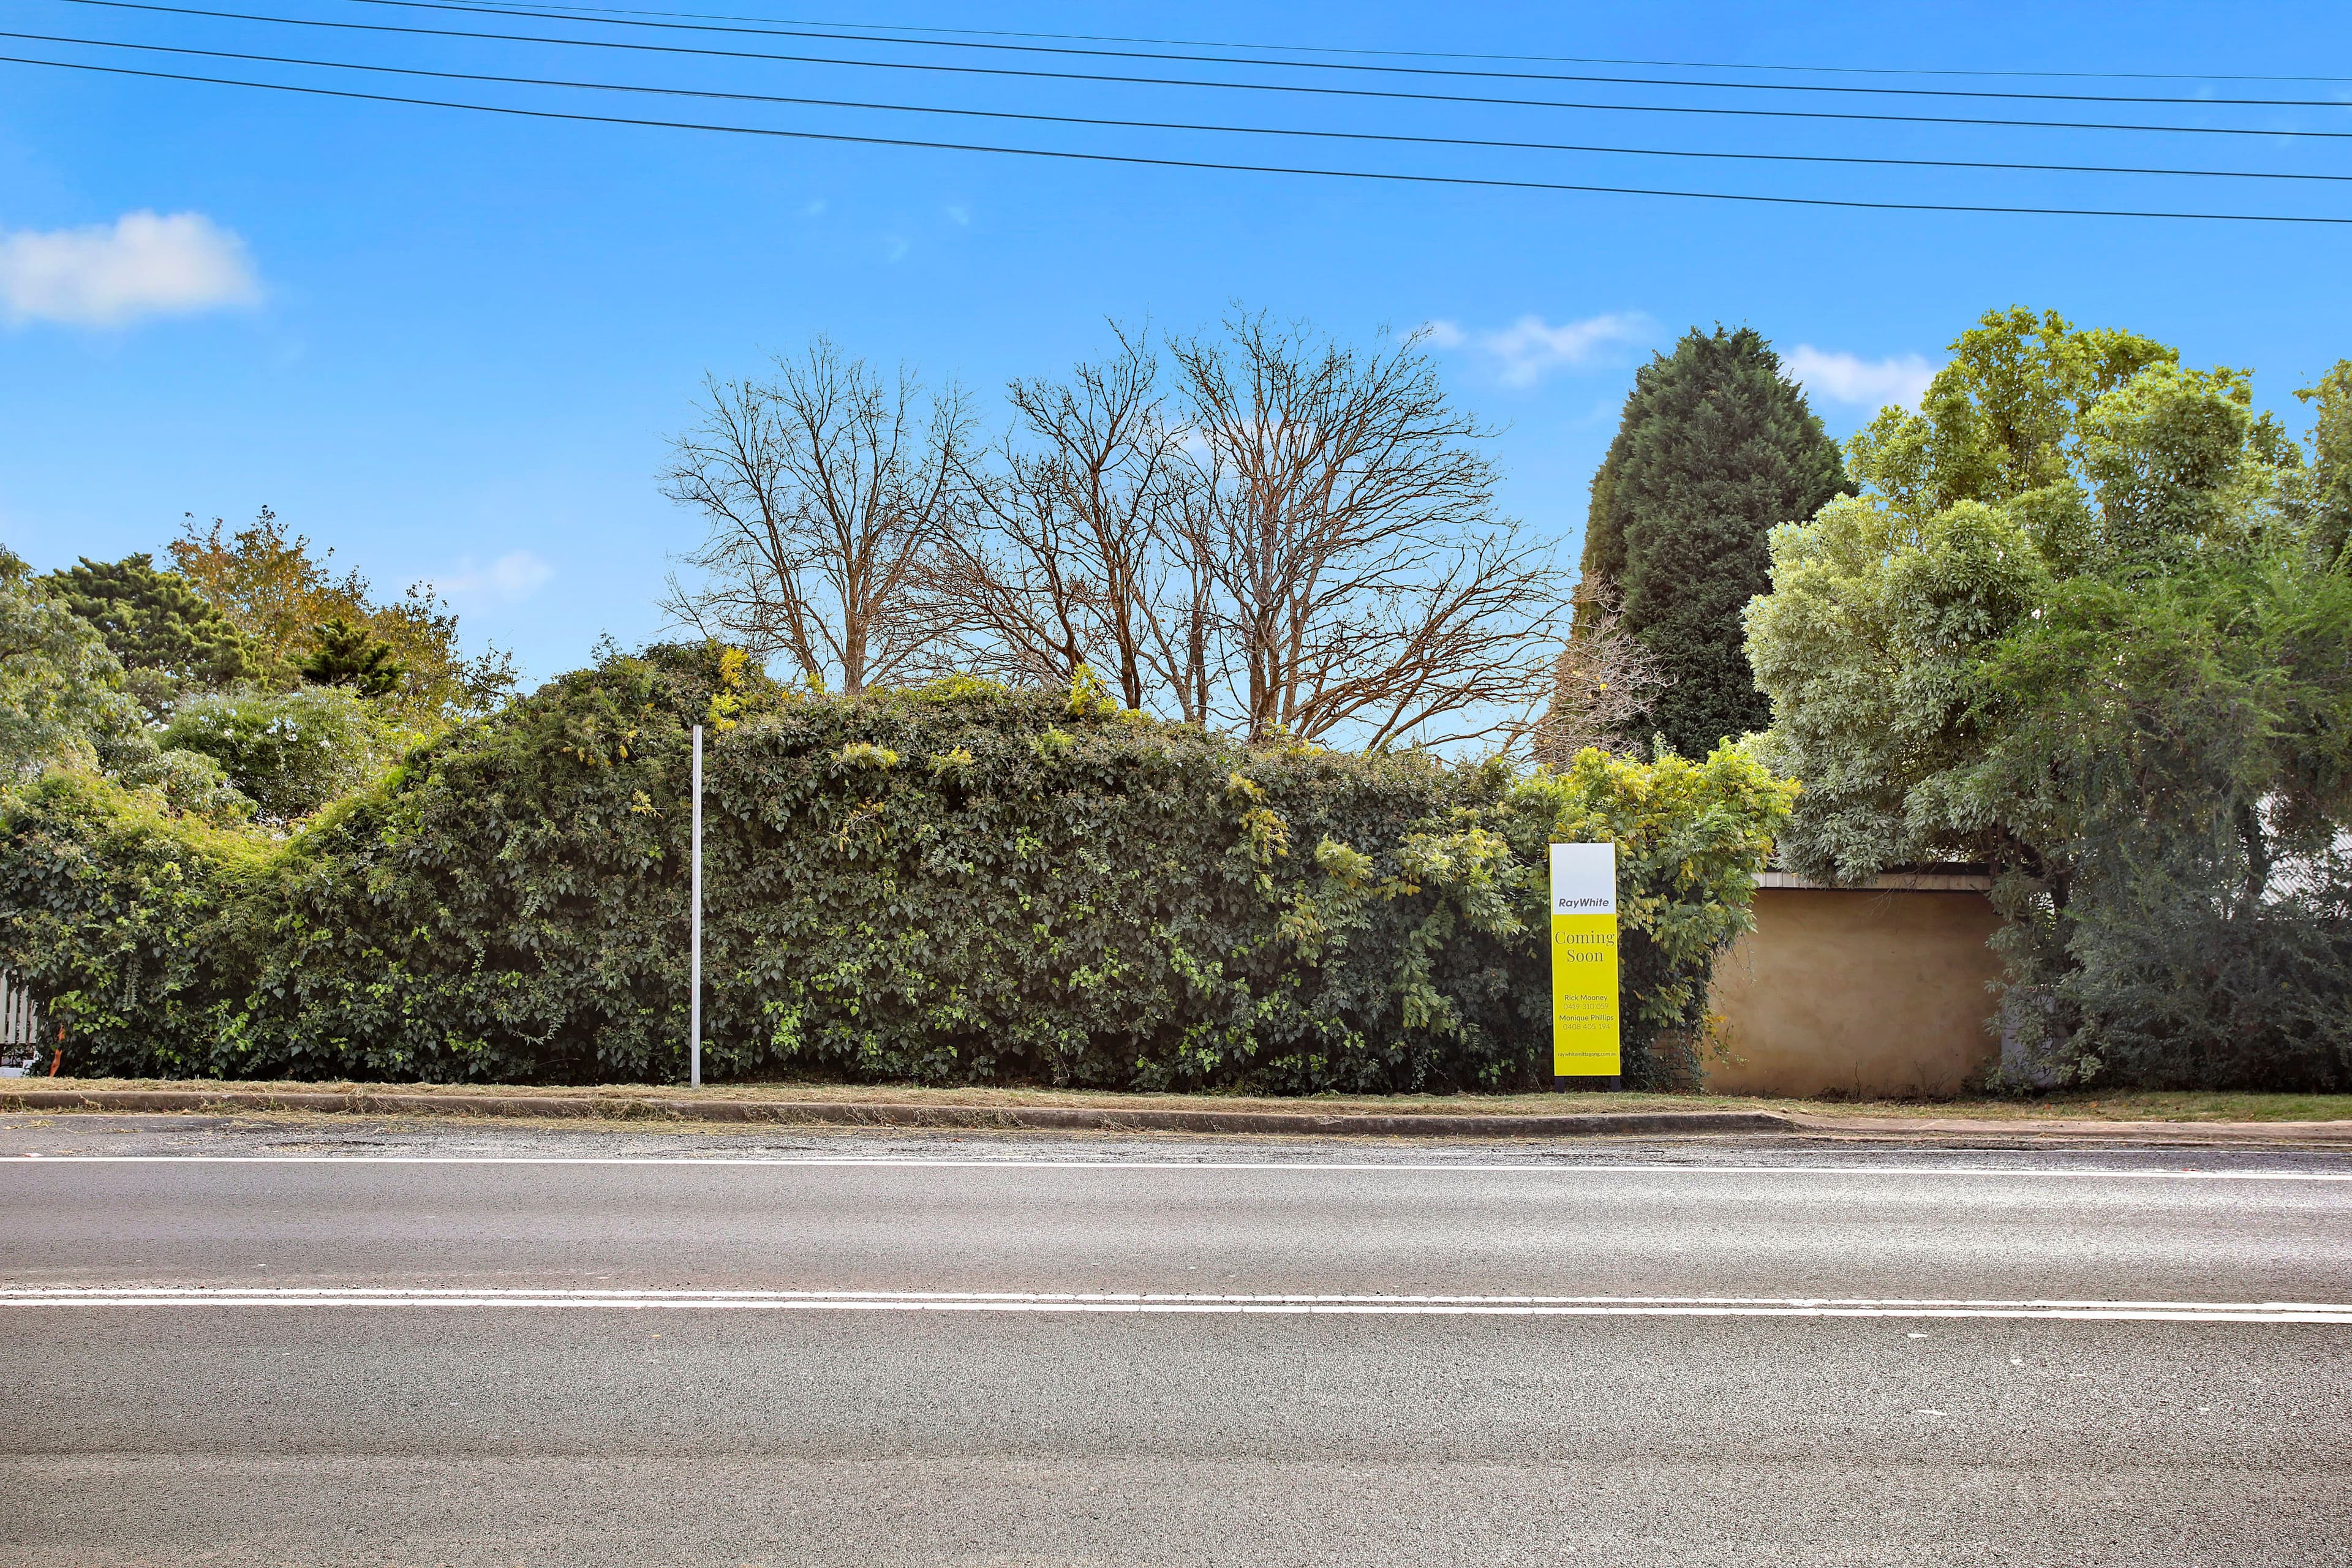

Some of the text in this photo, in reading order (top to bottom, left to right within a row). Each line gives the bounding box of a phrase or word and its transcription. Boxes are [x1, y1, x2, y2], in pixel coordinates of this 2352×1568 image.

[1559, 898, 1609, 908] RayWhite
[1555, 931, 1615, 946] Coming
[1567, 949, 1604, 962] Soon
